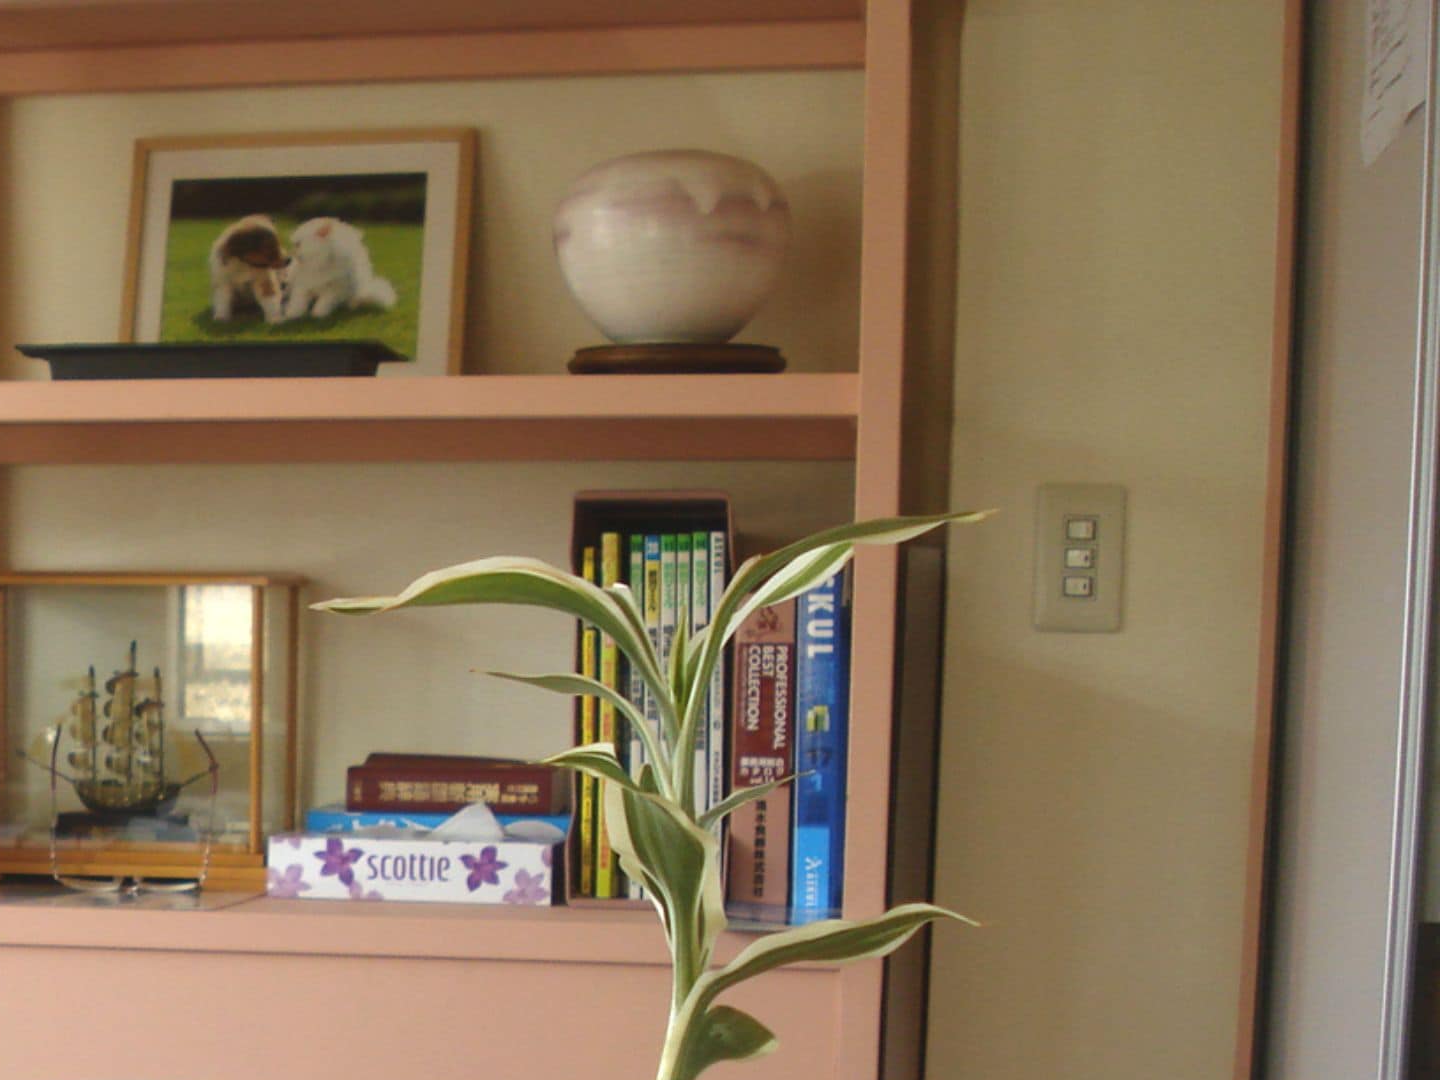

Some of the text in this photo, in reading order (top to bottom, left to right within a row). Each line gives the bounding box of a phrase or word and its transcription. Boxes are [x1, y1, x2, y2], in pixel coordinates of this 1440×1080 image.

[807, 575, 835, 658] SKUL
[746, 644, 762, 731] COLLECTION
[762, 645, 775, 677] BEST
[773, 644, 789, 750] PROFESSIONAL
[367, 852, 451, 883] scottie
